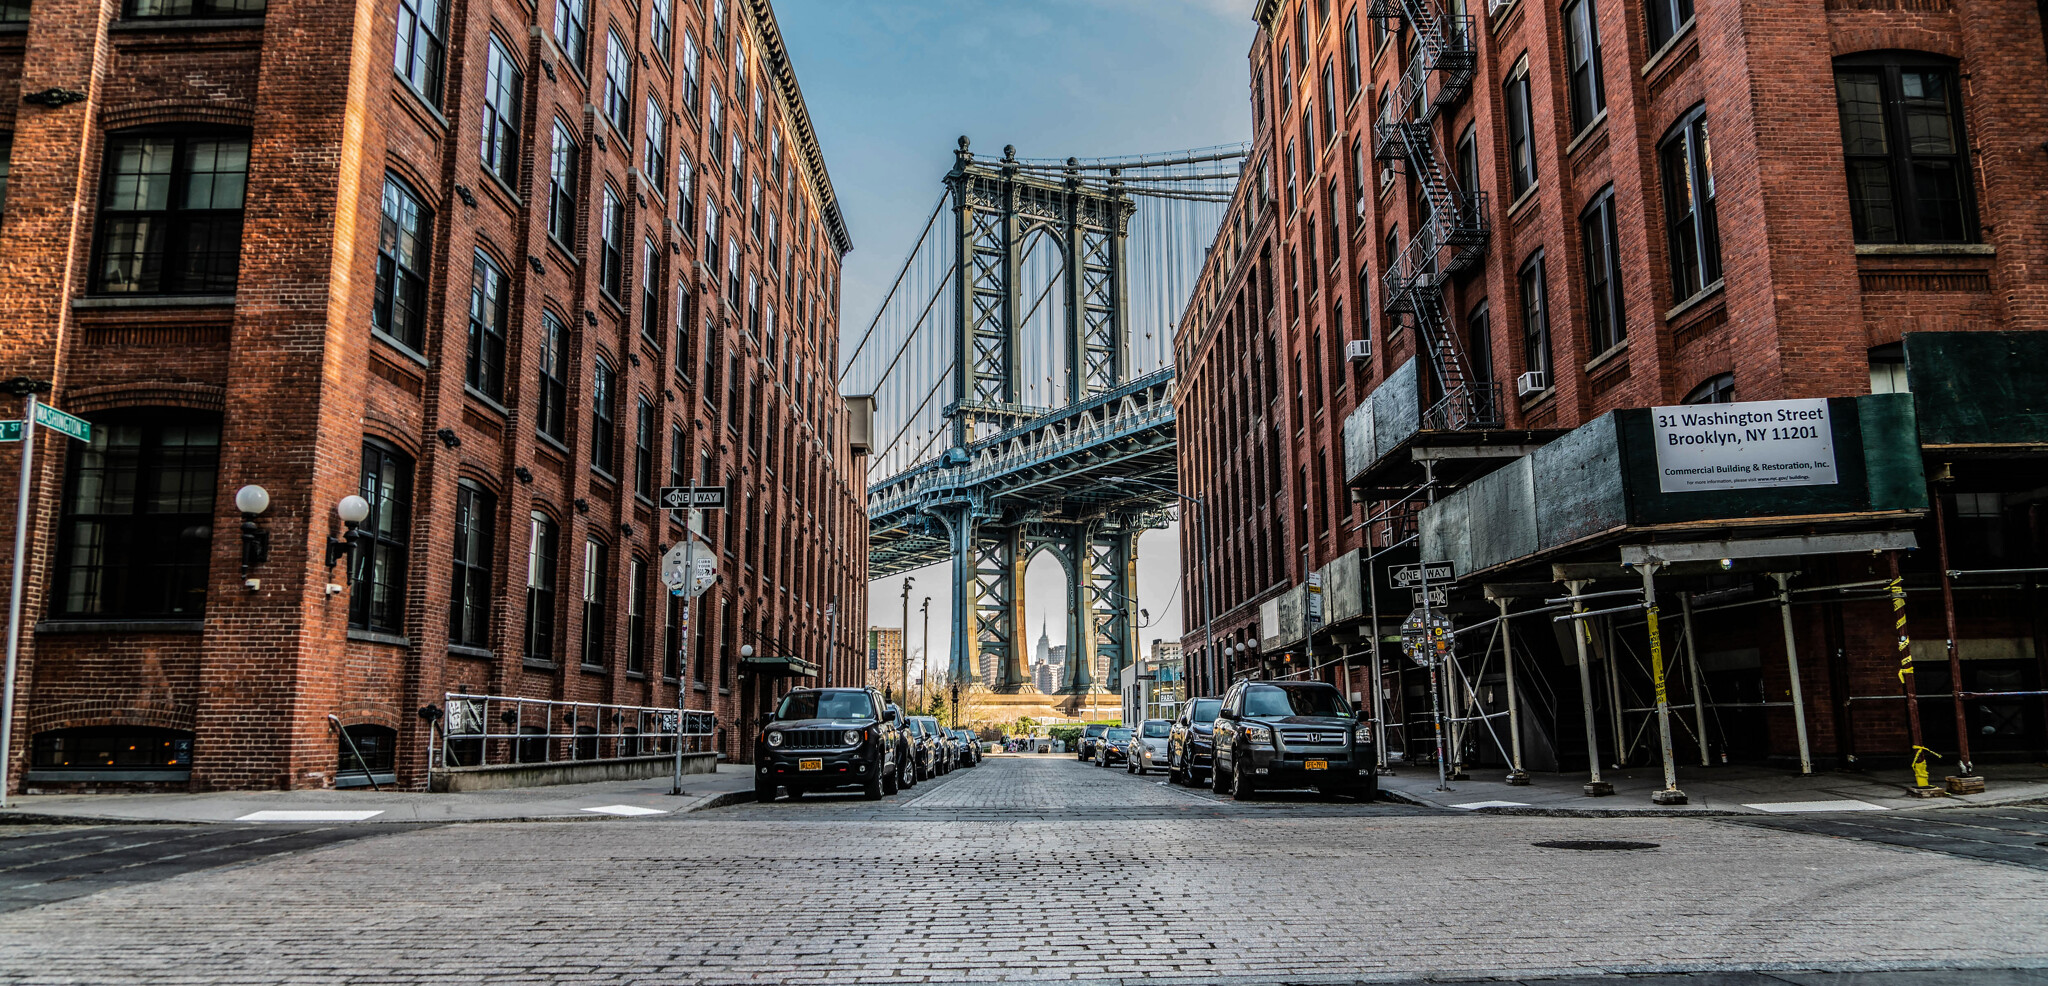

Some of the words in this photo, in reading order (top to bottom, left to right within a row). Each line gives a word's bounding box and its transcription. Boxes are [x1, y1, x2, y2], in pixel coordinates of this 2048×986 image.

[36, 404, 81, 436] WASHINGTON
[1659, 414, 1677, 428] 31
[1681, 411, 1773, 427] Washington
[1777, 408, 1824, 422] Street
[10, 423, 20, 432] ST
[1668, 430, 1741, 446] Brooklyn,
[1746, 428, 1767, 442] NY
[1772, 425, 1818, 440] 11201
[1664, 465, 1715, 476] Commercial
[1716, 464, 1751, 473] Building
[1752, 463, 1760, 472] &
[1761, 461, 1813, 471] Restoration,
[1814, 460, 1830, 469] Inc.
[670, 493, 689, 502] ONE
[697, 493, 717, 502] WAY
[1400, 570, 1419, 581] ONE
[1426, 568, 1446, 578] WAY
[1430, 591, 1442, 601] WAY
